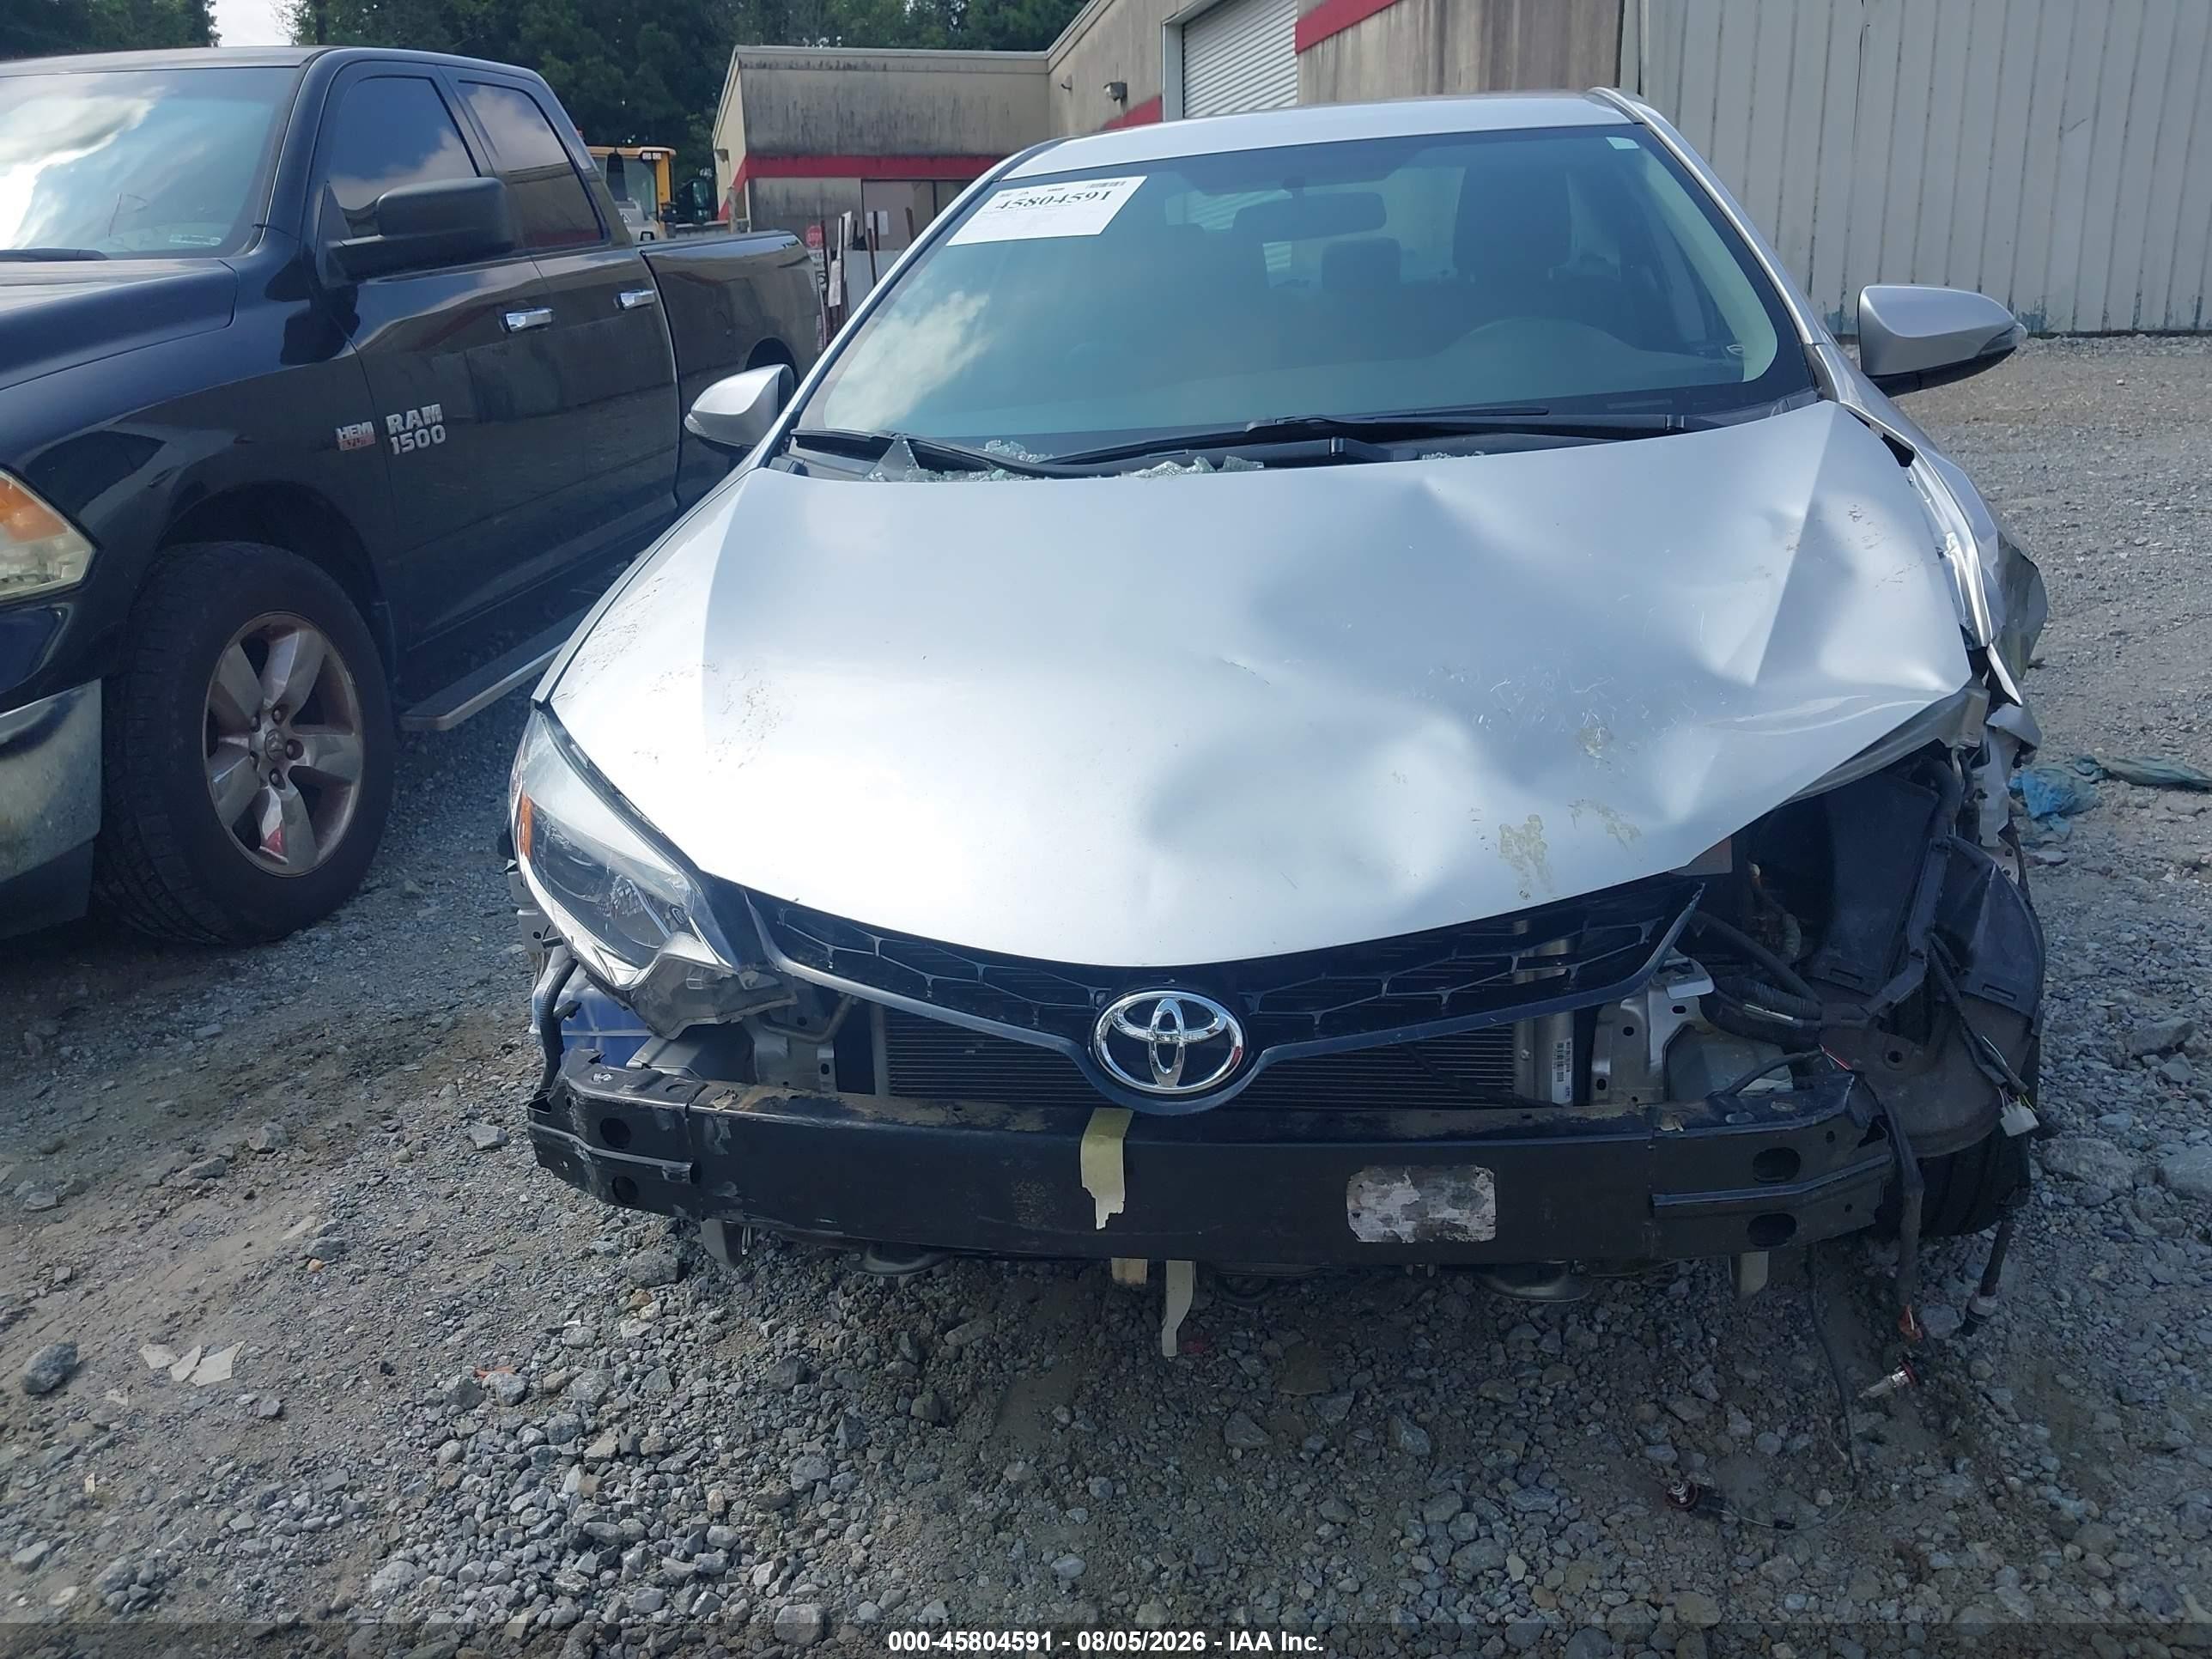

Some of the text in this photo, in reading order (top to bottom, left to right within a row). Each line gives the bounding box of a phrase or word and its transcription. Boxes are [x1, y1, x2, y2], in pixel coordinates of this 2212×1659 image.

[996, 191, 1113, 210] 45804591
[386, 404, 443, 435] RAM
[390, 424, 447, 455] 1500
